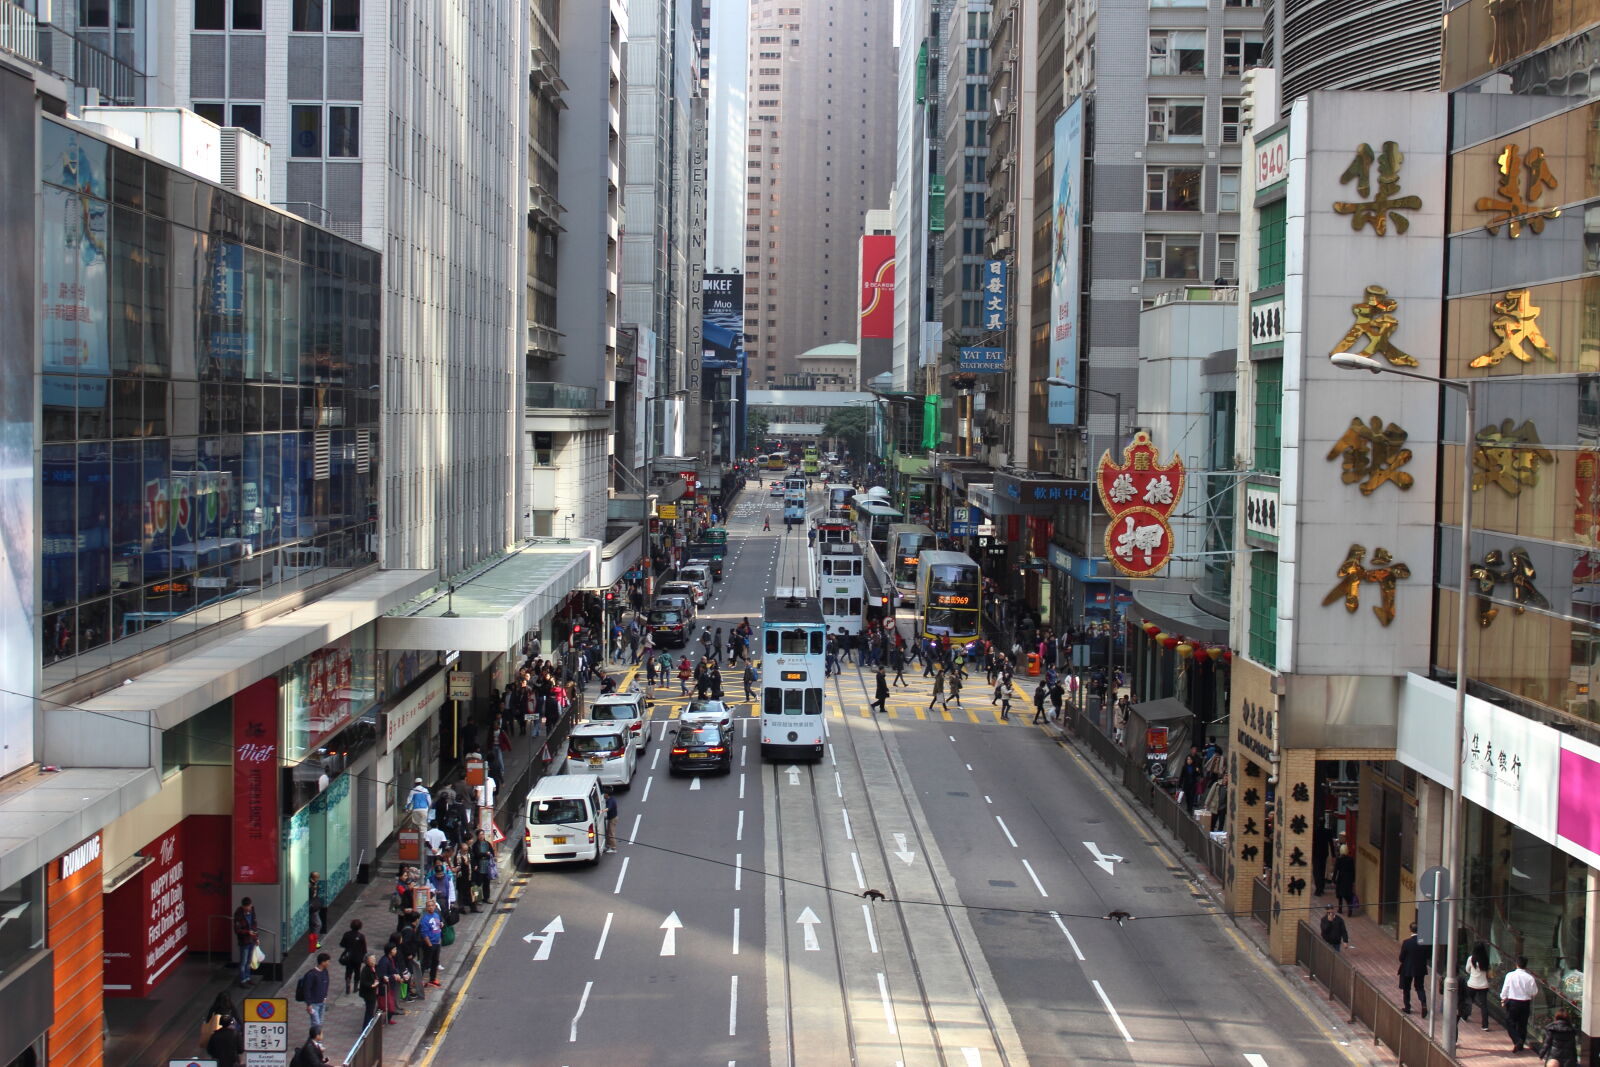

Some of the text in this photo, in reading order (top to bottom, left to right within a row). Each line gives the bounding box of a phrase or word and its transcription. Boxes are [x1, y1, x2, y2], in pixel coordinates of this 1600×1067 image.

[1258, 143, 1283, 183] 1940
[691, 263, 701, 310] FUR
[986, 261, 1004, 331] 日發文具
[714, 300, 732, 309] Muo
[690, 325, 700, 406] STORE
[960, 362, 1004, 370] STATIONERS
[963, 351, 1003, 360] YAT FAT
[1115, 516, 1165, 566] 押
[956, 597, 969, 605] 969
[63, 835, 100, 880] RUNNING
[151, 861, 183, 900] HAPPY HOUR
[151, 899, 161, 920] 4-7
[161, 896, 170, 913] PM
[148, 920, 161, 945] First
[161, 910, 175, 935] Drink
[260, 1025, 285, 1035] 8-10
[260, 1039, 281, 1048] 5-7
